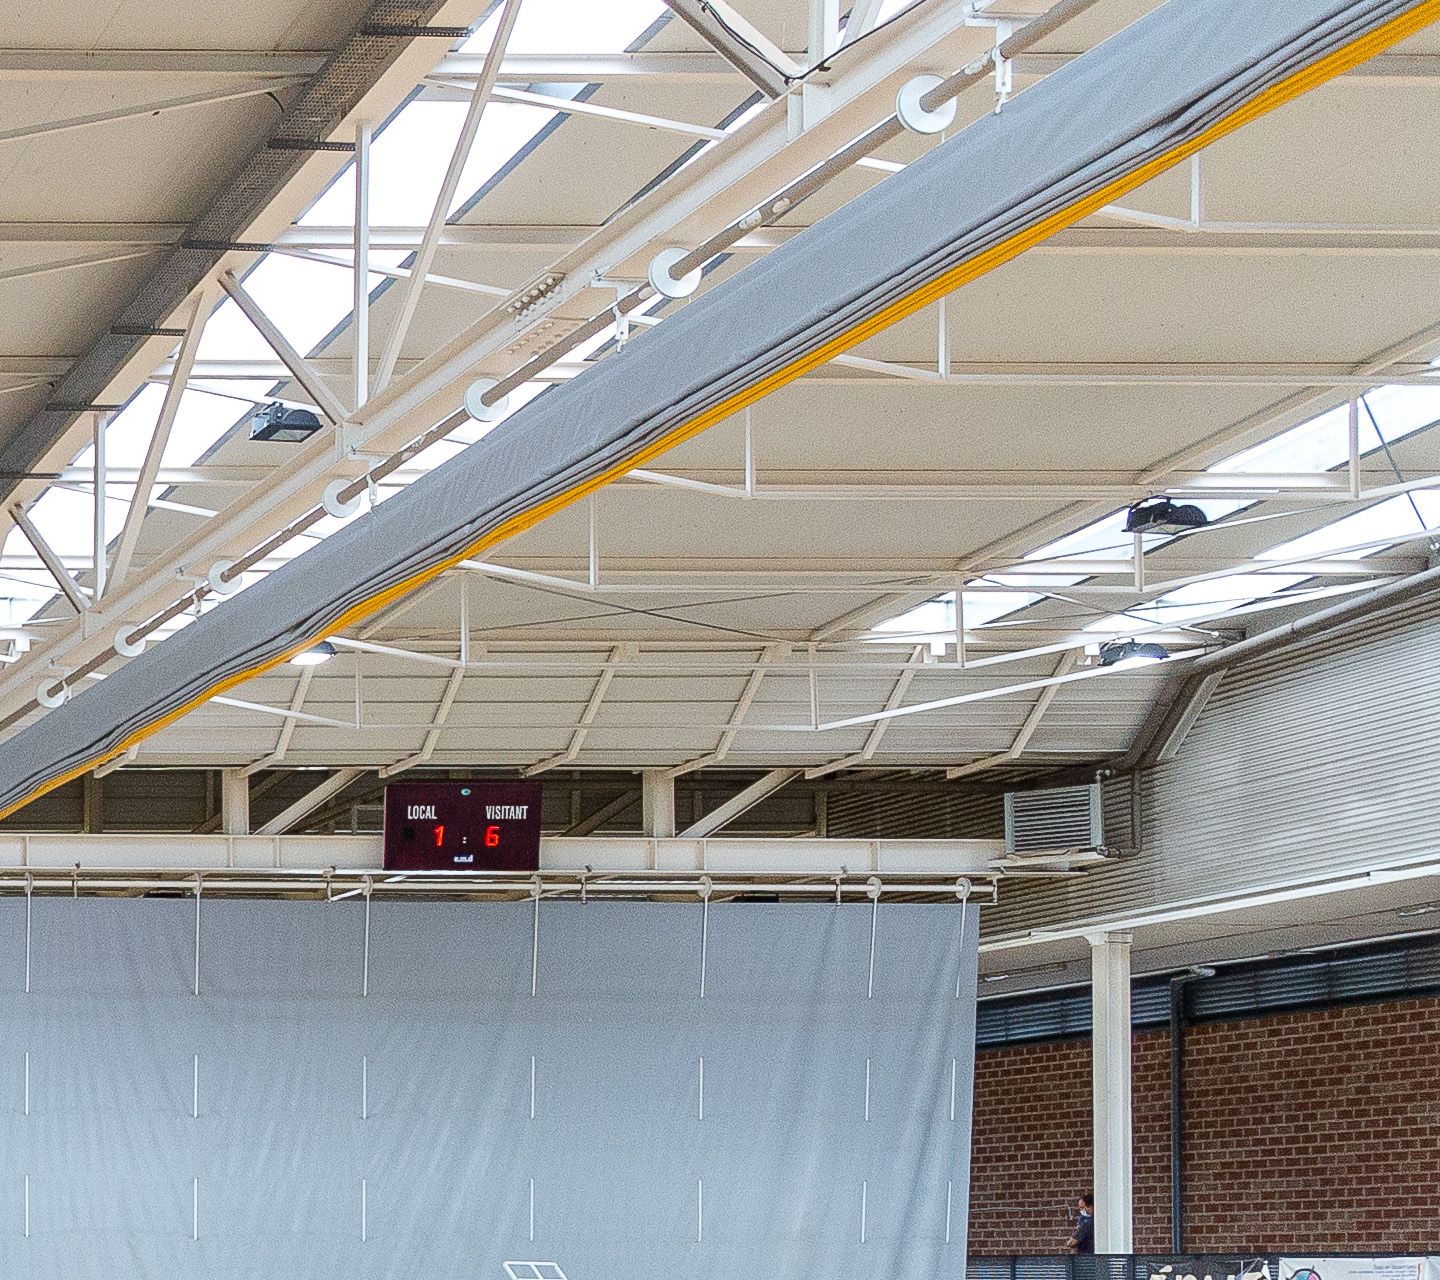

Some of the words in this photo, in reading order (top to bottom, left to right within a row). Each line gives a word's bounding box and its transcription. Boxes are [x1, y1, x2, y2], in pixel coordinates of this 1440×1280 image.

[408, 805, 437, 820] LOCAL
[485, 805, 529, 820] VISITANT
[434, 825, 445, 847] 1
[484, 825, 500, 847] 6
